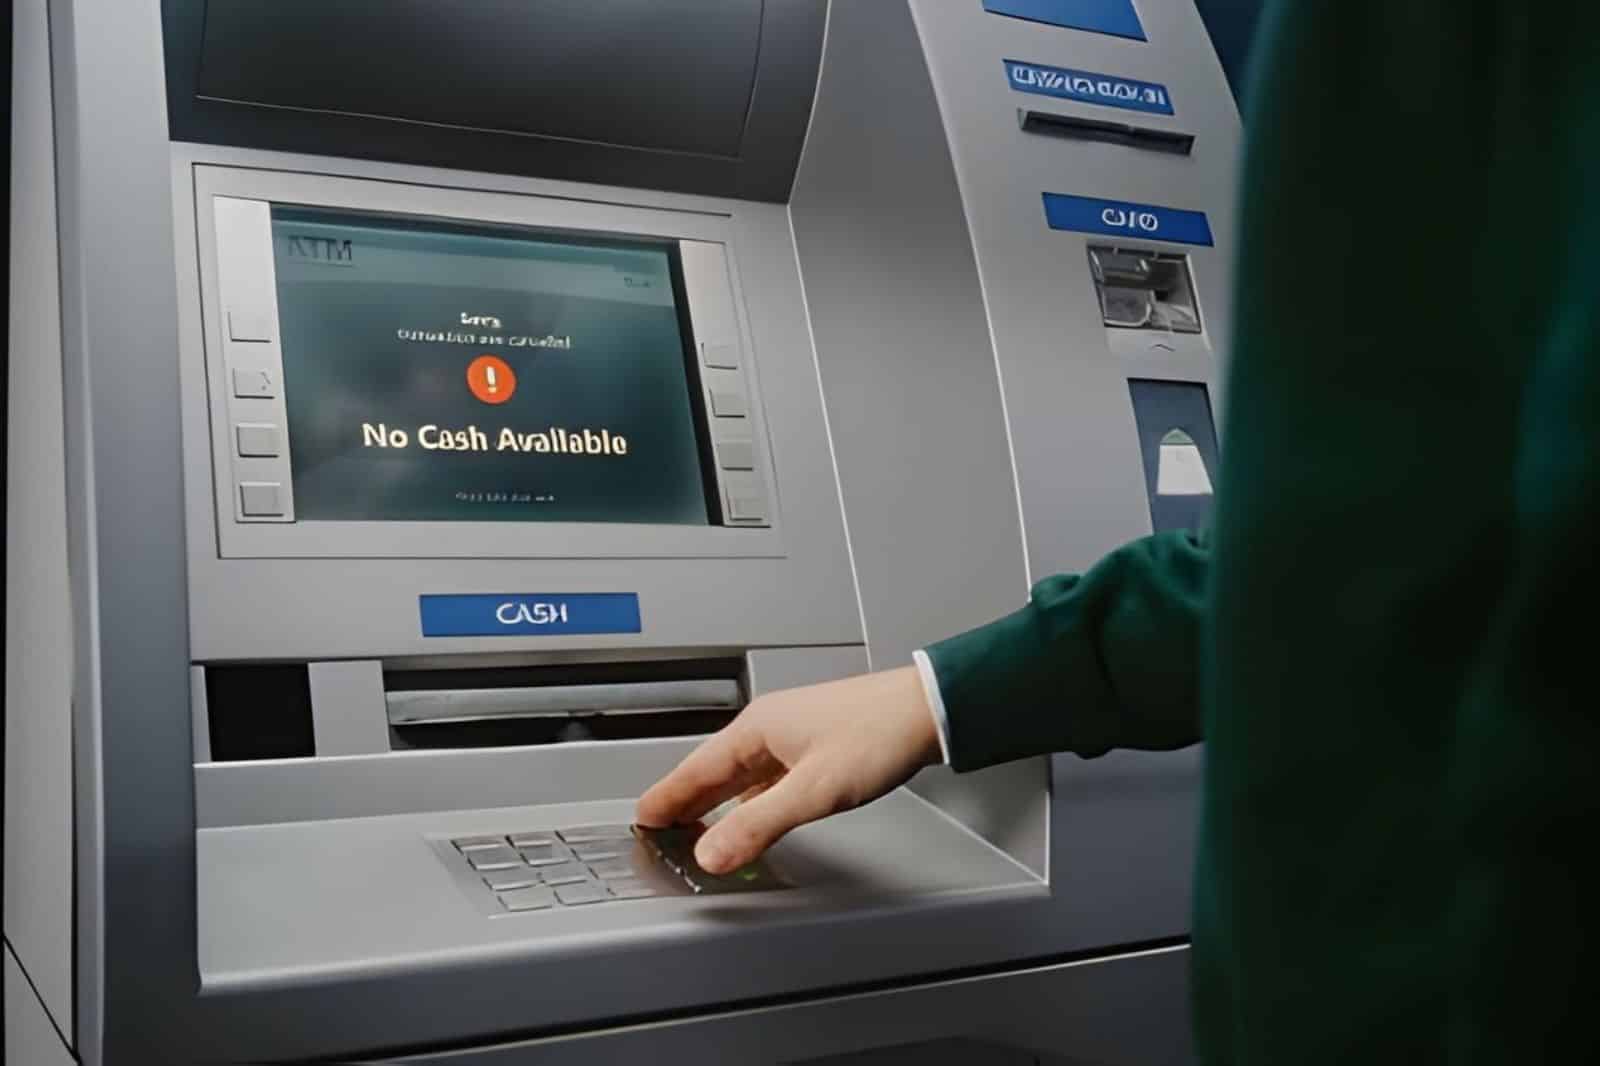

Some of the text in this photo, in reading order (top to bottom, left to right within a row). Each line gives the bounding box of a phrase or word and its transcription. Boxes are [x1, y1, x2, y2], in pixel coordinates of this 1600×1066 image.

[362, 423, 628, 455] No Cash Available
[496, 603, 568, 624] CASH
